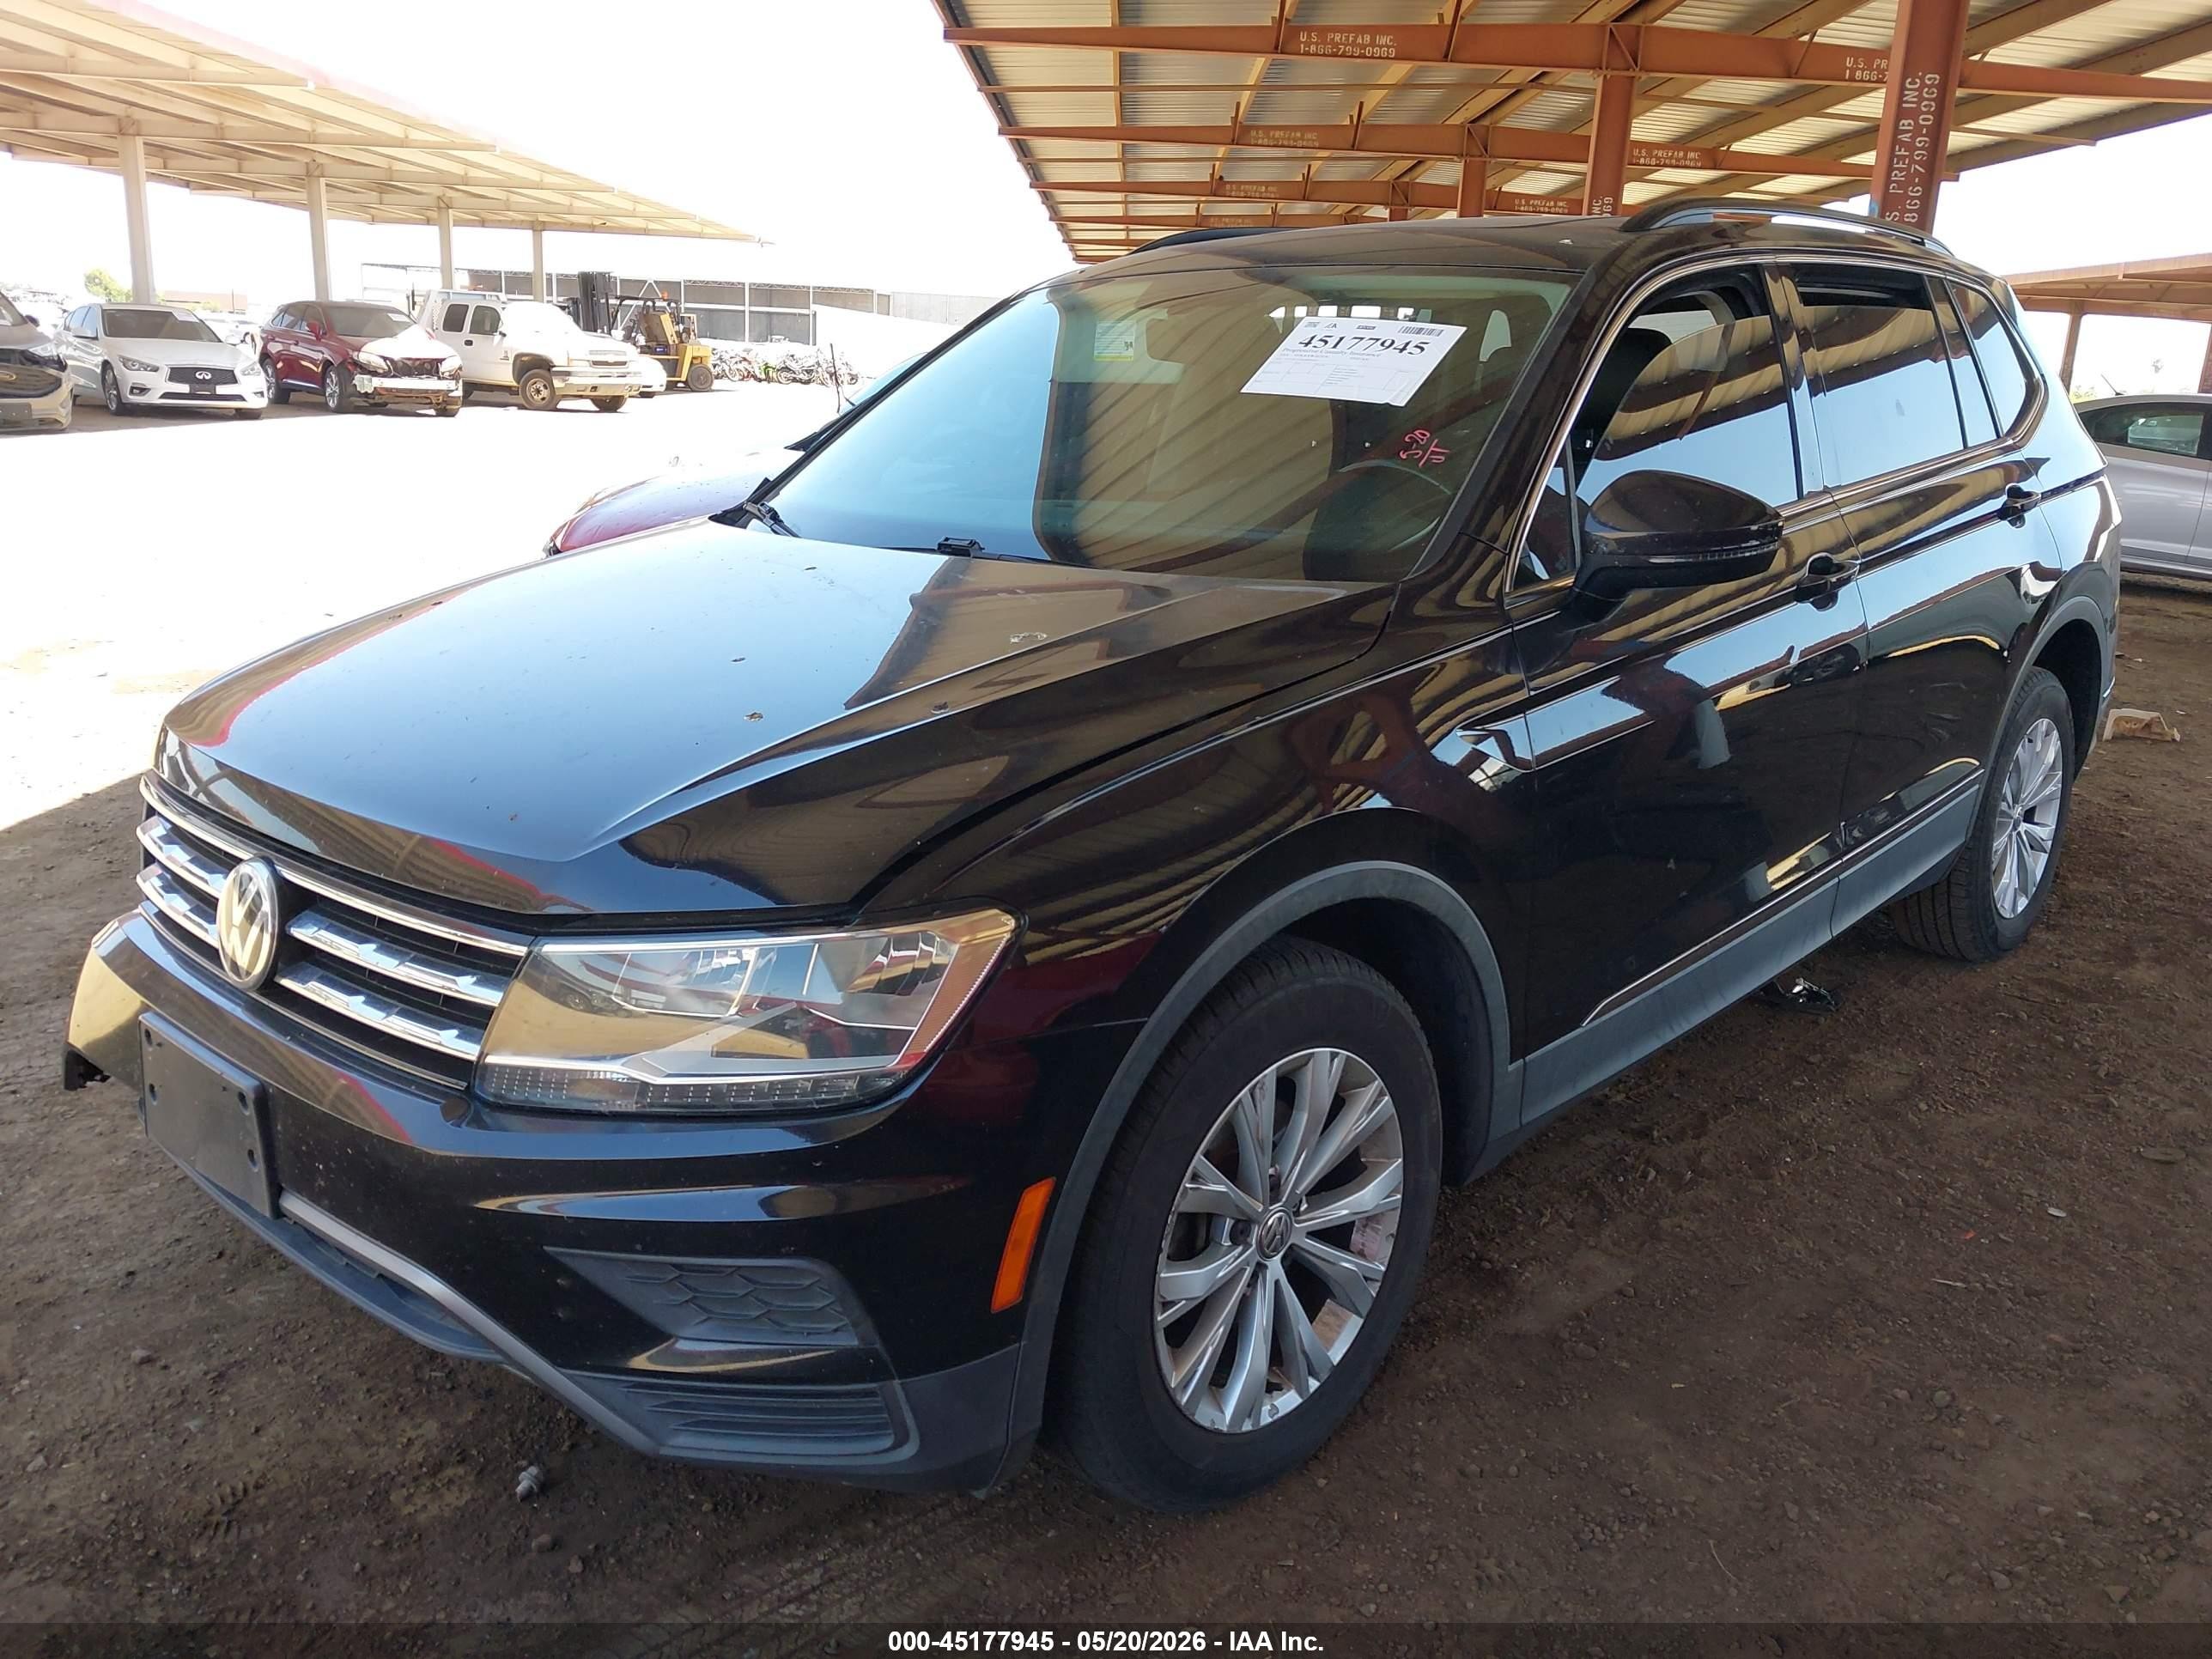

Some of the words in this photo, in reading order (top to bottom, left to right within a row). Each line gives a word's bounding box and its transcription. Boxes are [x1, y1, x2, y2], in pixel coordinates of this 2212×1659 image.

[1299, 31, 1321, 43] U.S.
[1327, 33, 1371, 45] PREFAB
[1376, 34, 1397, 46] INC.
[1299, 43, 1395, 58] 1-866-799-0969
[1846, 57, 1868, 69] U.S.
[1874, 58, 1888, 70] PR
[1889, 118, 1914, 193] PREFAB
[1903, 71, 1923, 108] INC.
[1653, 149, 1684, 159] PREFAB
[1297, 334, 1431, 356] 45177945
